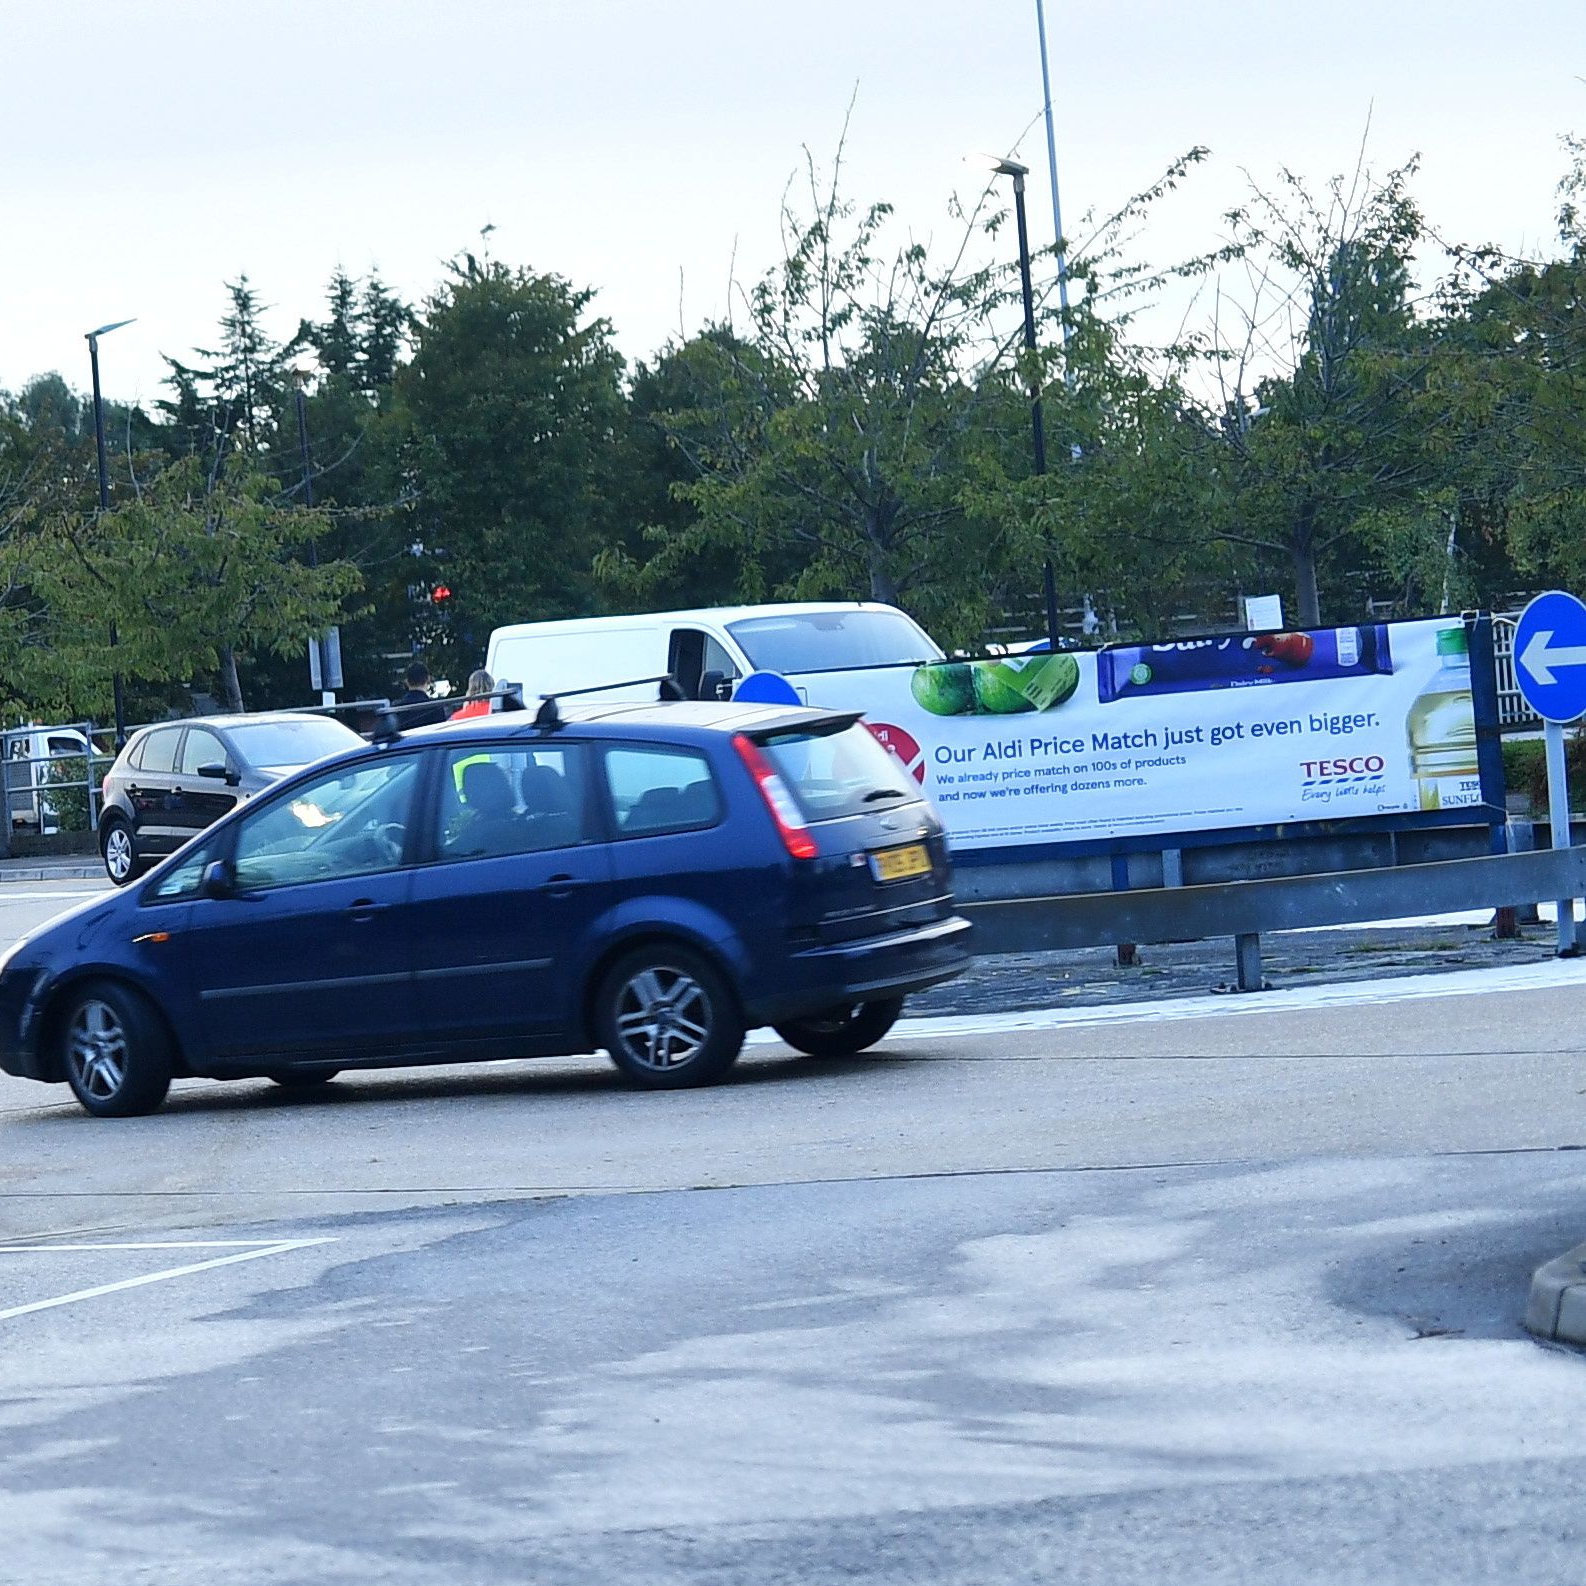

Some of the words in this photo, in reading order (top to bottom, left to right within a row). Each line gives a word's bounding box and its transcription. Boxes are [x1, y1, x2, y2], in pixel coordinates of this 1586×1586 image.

[935, 745, 976, 764] Our
[983, 739, 1022, 761] Aldi
[1030, 736, 1085, 757] Price
[1092, 729, 1157, 751] Match
[1163, 725, 1204, 750] just
[1210, 721, 1245, 746] got
[1251, 718, 1302, 738] even
[1309, 712, 1380, 735] bigger.
[936, 774, 955, 785] We
[958, 770, 999, 784] already
[1002, 768, 1031, 782] price
[1034, 764, 1070, 777] match
[1073, 765, 1088, 774] on
[1091, 760, 1118, 772] 100s
[1120, 758, 1132, 770] of
[1135, 755, 1186, 770] products
[1300, 755, 1385, 778] TESCO
[938, 790, 960, 802] and
[963, 789, 987, 800] now
[989, 786, 1021, 798] we're
[1024, 782, 1068, 796] offering
[1071, 780, 1111, 791] dozens
[1114, 777, 1147, 788] more.
